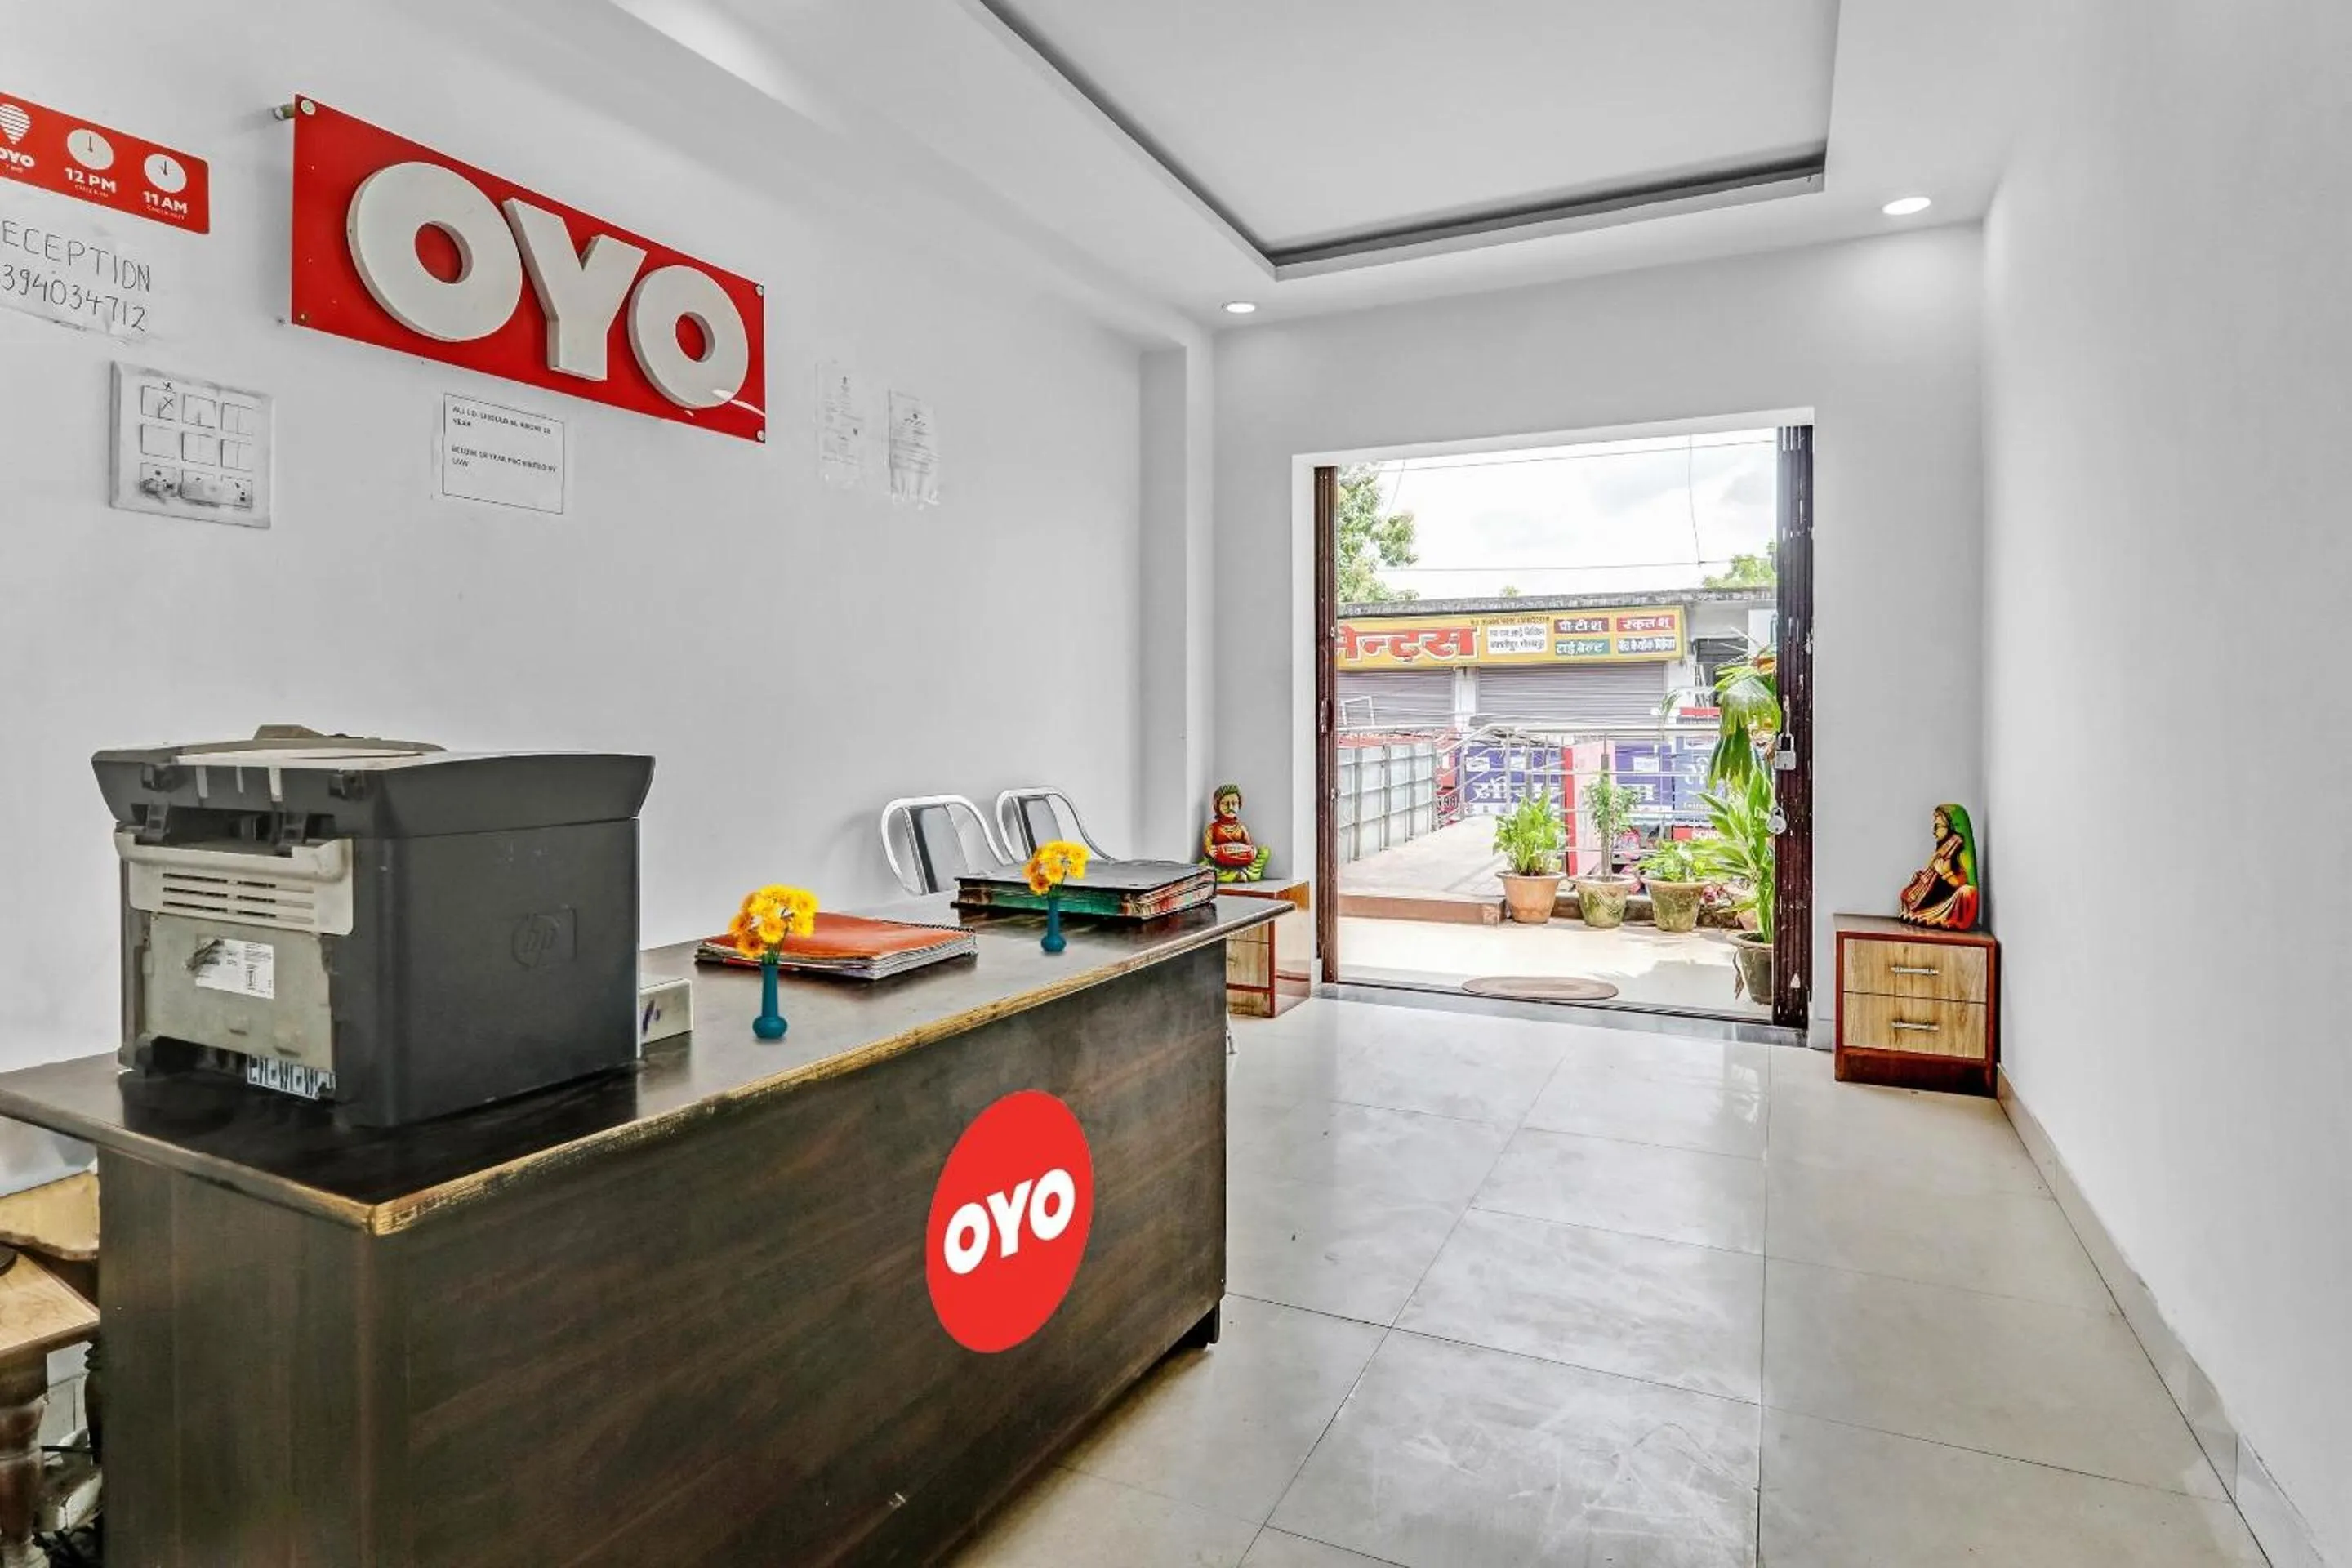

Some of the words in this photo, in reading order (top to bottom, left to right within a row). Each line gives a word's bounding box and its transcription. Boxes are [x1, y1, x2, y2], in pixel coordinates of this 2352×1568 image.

[65, 167, 85, 184] 12
[88, 175, 117, 194] PM
[142, 191, 158, 206] 11
[162, 196, 188, 214] AM
[346, 161, 750, 409] OYO
